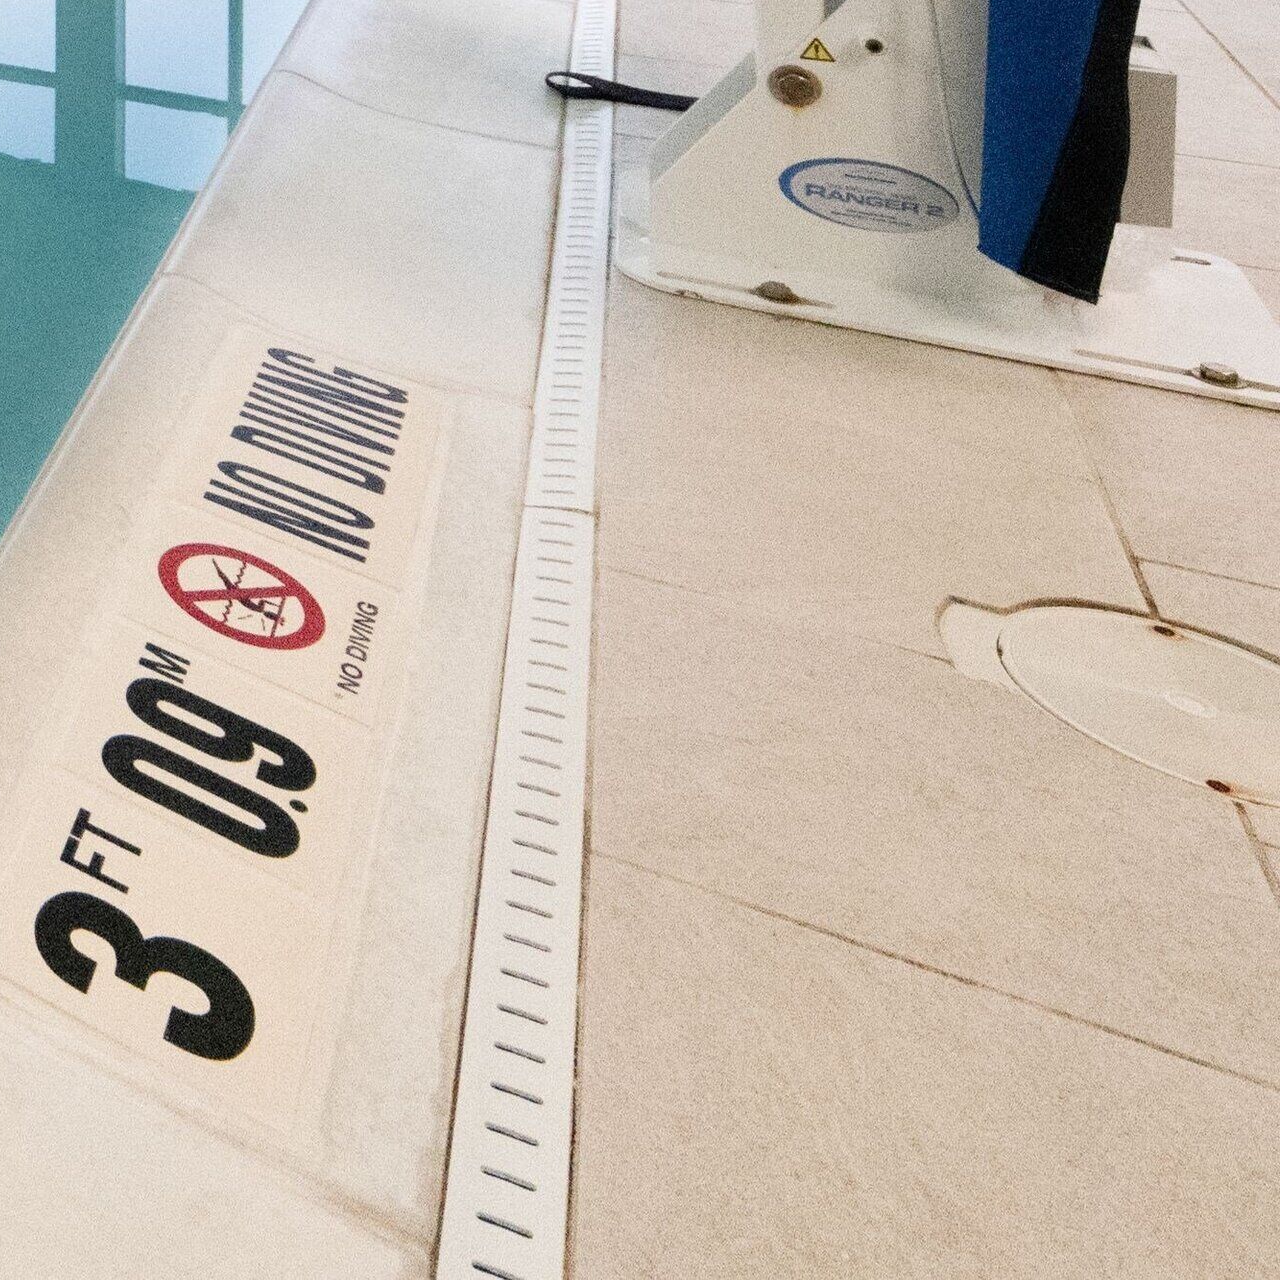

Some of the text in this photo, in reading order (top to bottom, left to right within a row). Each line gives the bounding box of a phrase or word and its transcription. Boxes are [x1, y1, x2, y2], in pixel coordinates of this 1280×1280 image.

[804, 183, 920, 216] RANGER
[926, 203, 946, 219] 2
[336, 600, 379, 695] NO DIVING
[34, 348, 409, 1061] 3 FT 0.9 M NO DIVING
